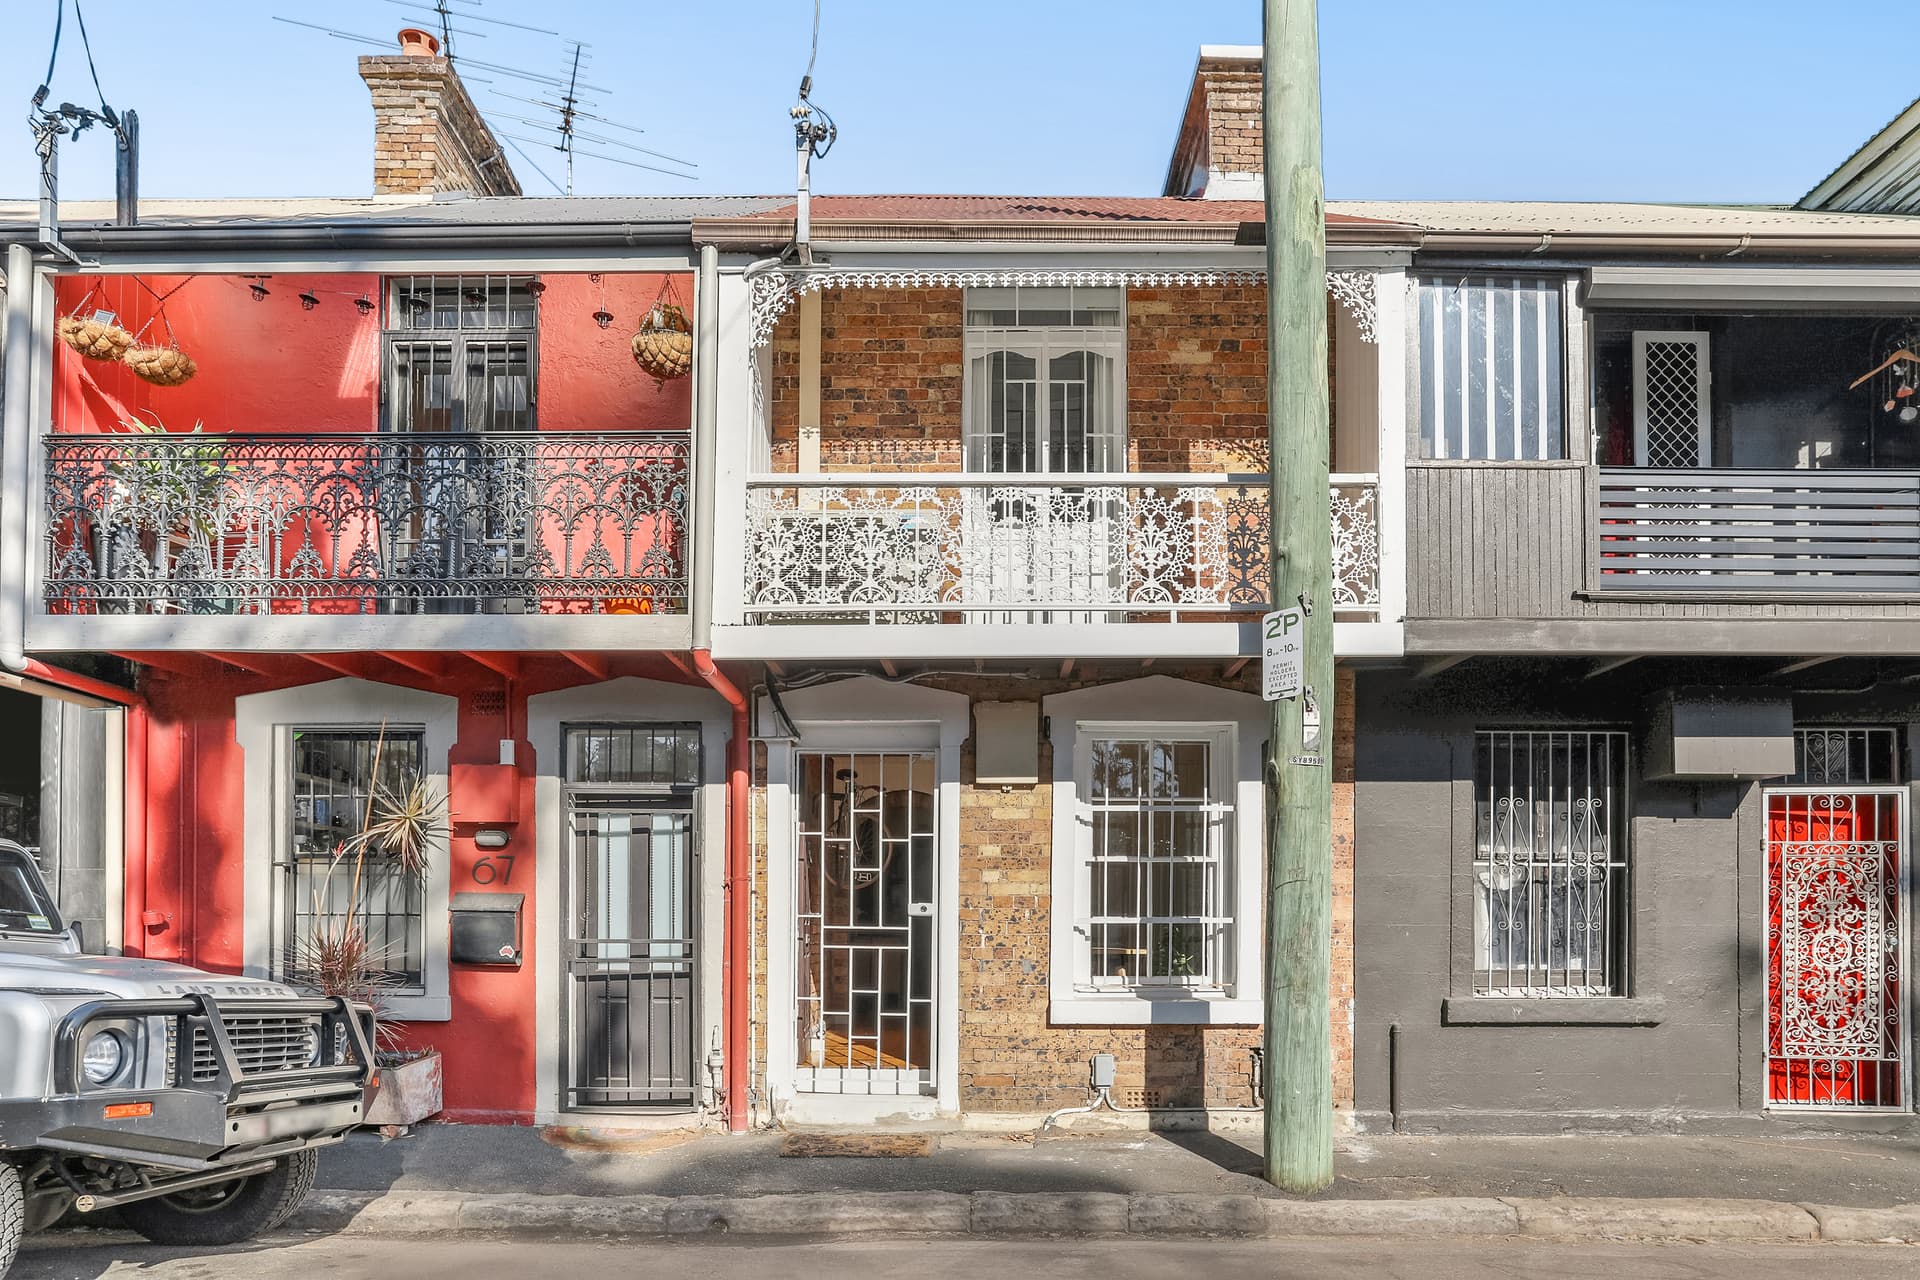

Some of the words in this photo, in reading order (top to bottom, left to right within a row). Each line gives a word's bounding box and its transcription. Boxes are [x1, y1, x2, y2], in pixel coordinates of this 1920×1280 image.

[1266, 613, 1299, 639] 2P
[472, 856, 516, 885] 67
[157, 985, 216, 995] LAND
[225, 986, 286, 996] ROVER
